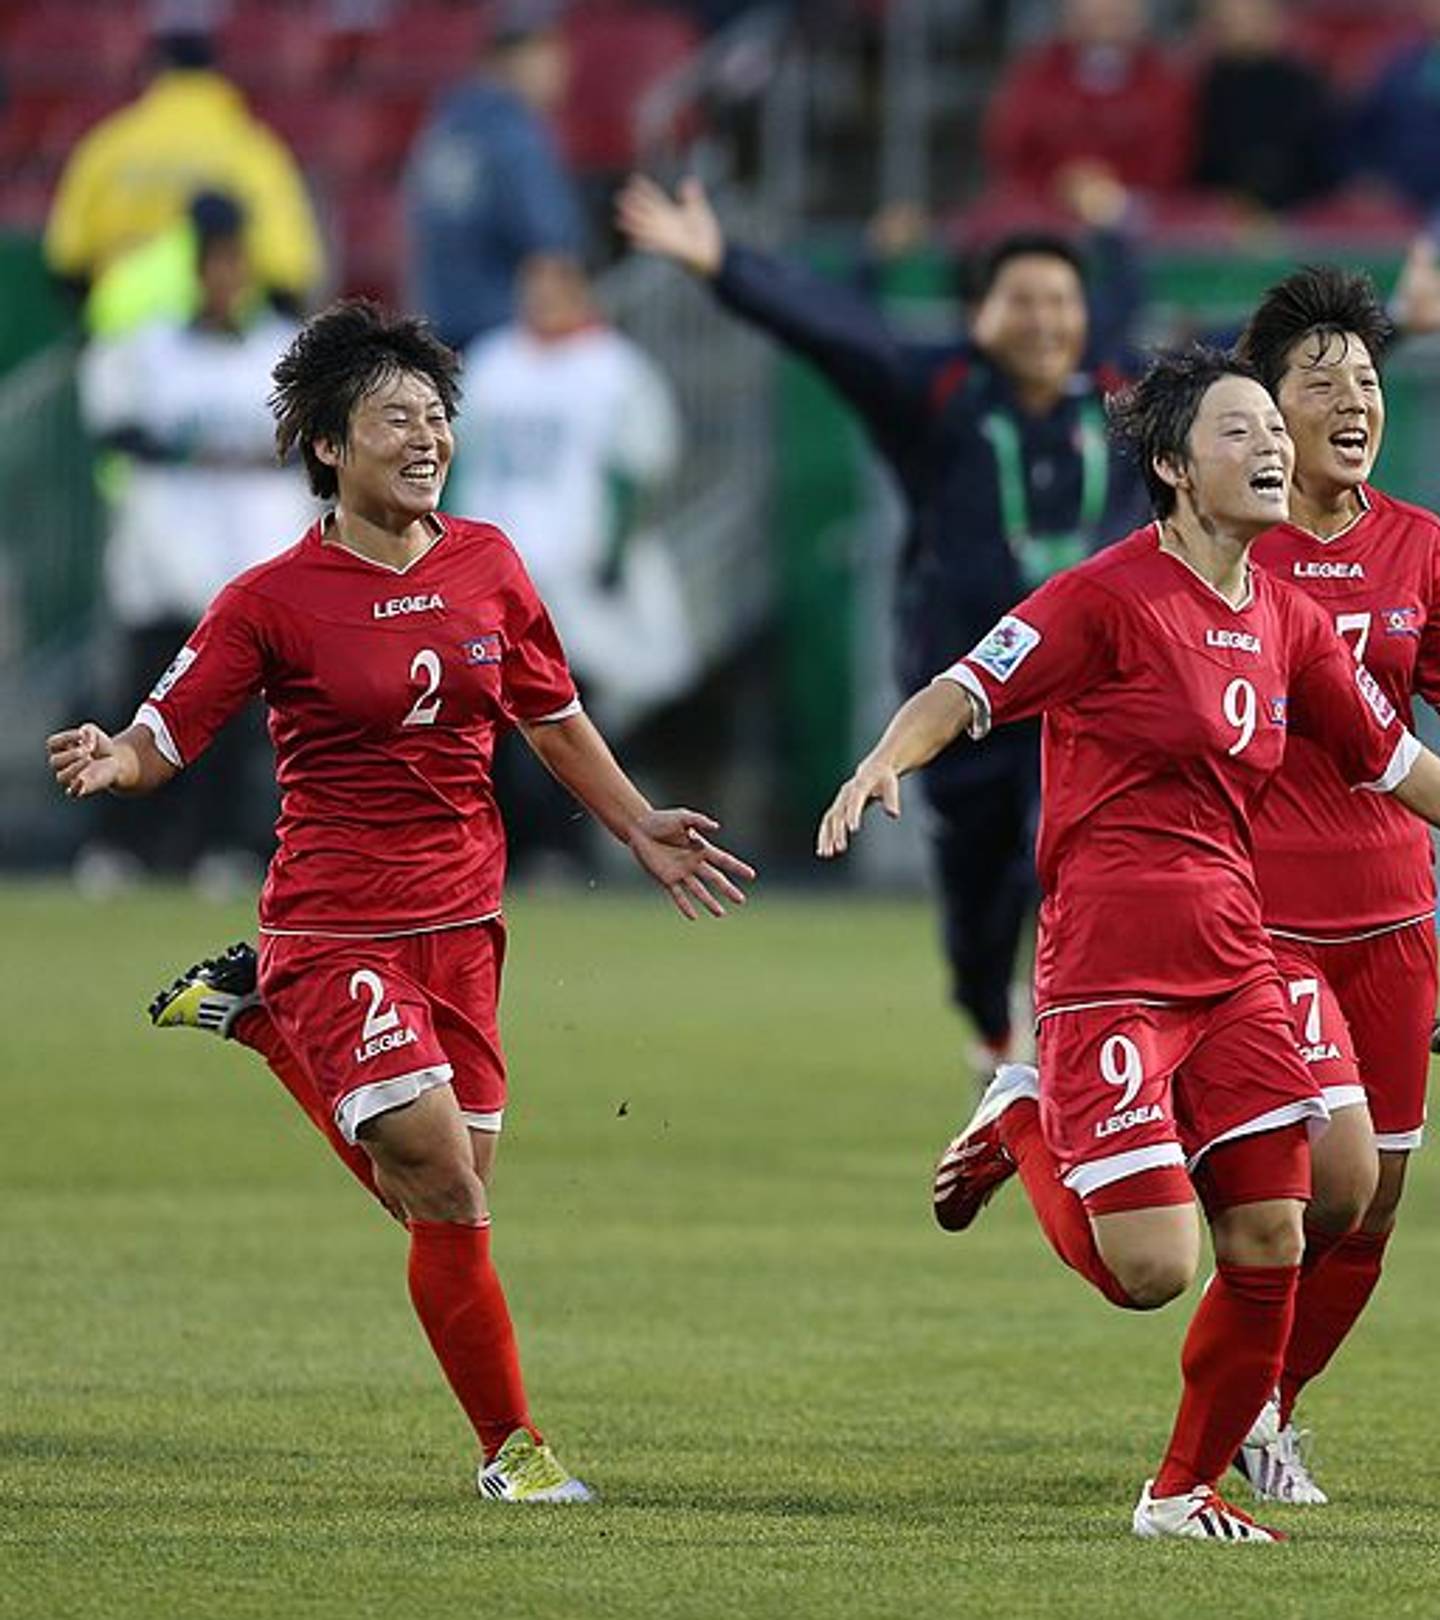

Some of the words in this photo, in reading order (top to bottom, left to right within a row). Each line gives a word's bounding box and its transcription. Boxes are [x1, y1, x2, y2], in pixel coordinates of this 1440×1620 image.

[1293, 561, 1365, 578] LEGEA
[373, 593, 445, 619] LEGEA
[1205, 629, 1262, 654] LEGEA
[1335, 612, 1371, 665] 7
[402, 648, 442, 726] 2
[1223, 677, 1257, 756] 9
[349, 968, 400, 1042] 2
[1288, 978, 1320, 1044] 7
[355, 1027, 418, 1063] LEGEA
[1099, 1034, 1144, 1112] 9
[1094, 1104, 1164, 1138] LEGEA
